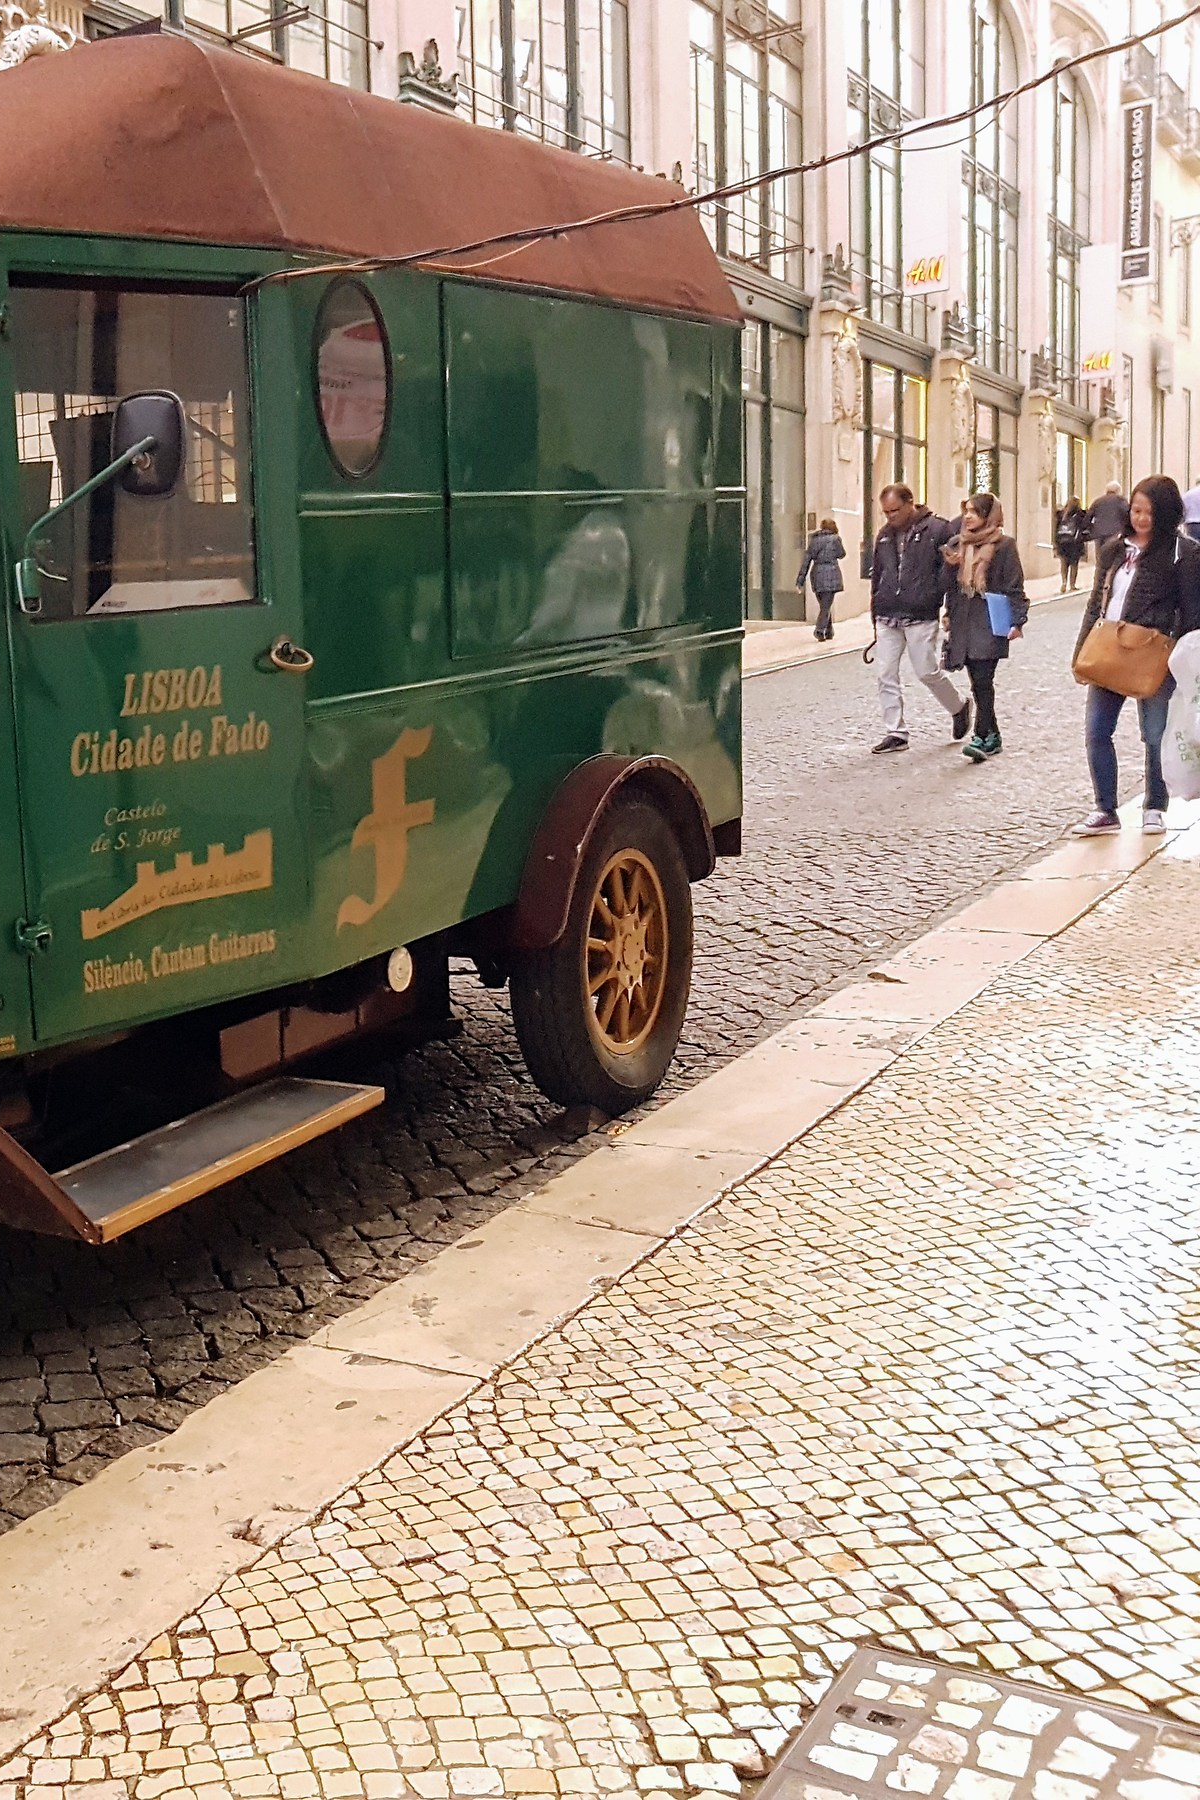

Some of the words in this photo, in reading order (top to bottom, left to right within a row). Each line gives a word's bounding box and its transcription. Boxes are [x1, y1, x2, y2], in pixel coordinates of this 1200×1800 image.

[906, 255, 945, 285] H&M
[120, 664, 222, 717] LISBOA
[70, 725, 166, 777] Cidade
[172, 720, 203, 762] de
[208, 711, 270, 757] Fado
[104, 799, 167, 826] Castelo
[91, 832, 111, 853] de
[114, 831, 130, 850] S.
[136, 826, 182, 849] Jorge
[158, 878, 203, 899] Cidade
[84, 952, 149, 993] Silêncio,
[152, 942, 206, 978] Cantam
[209, 929, 276, 965] Guitarras
